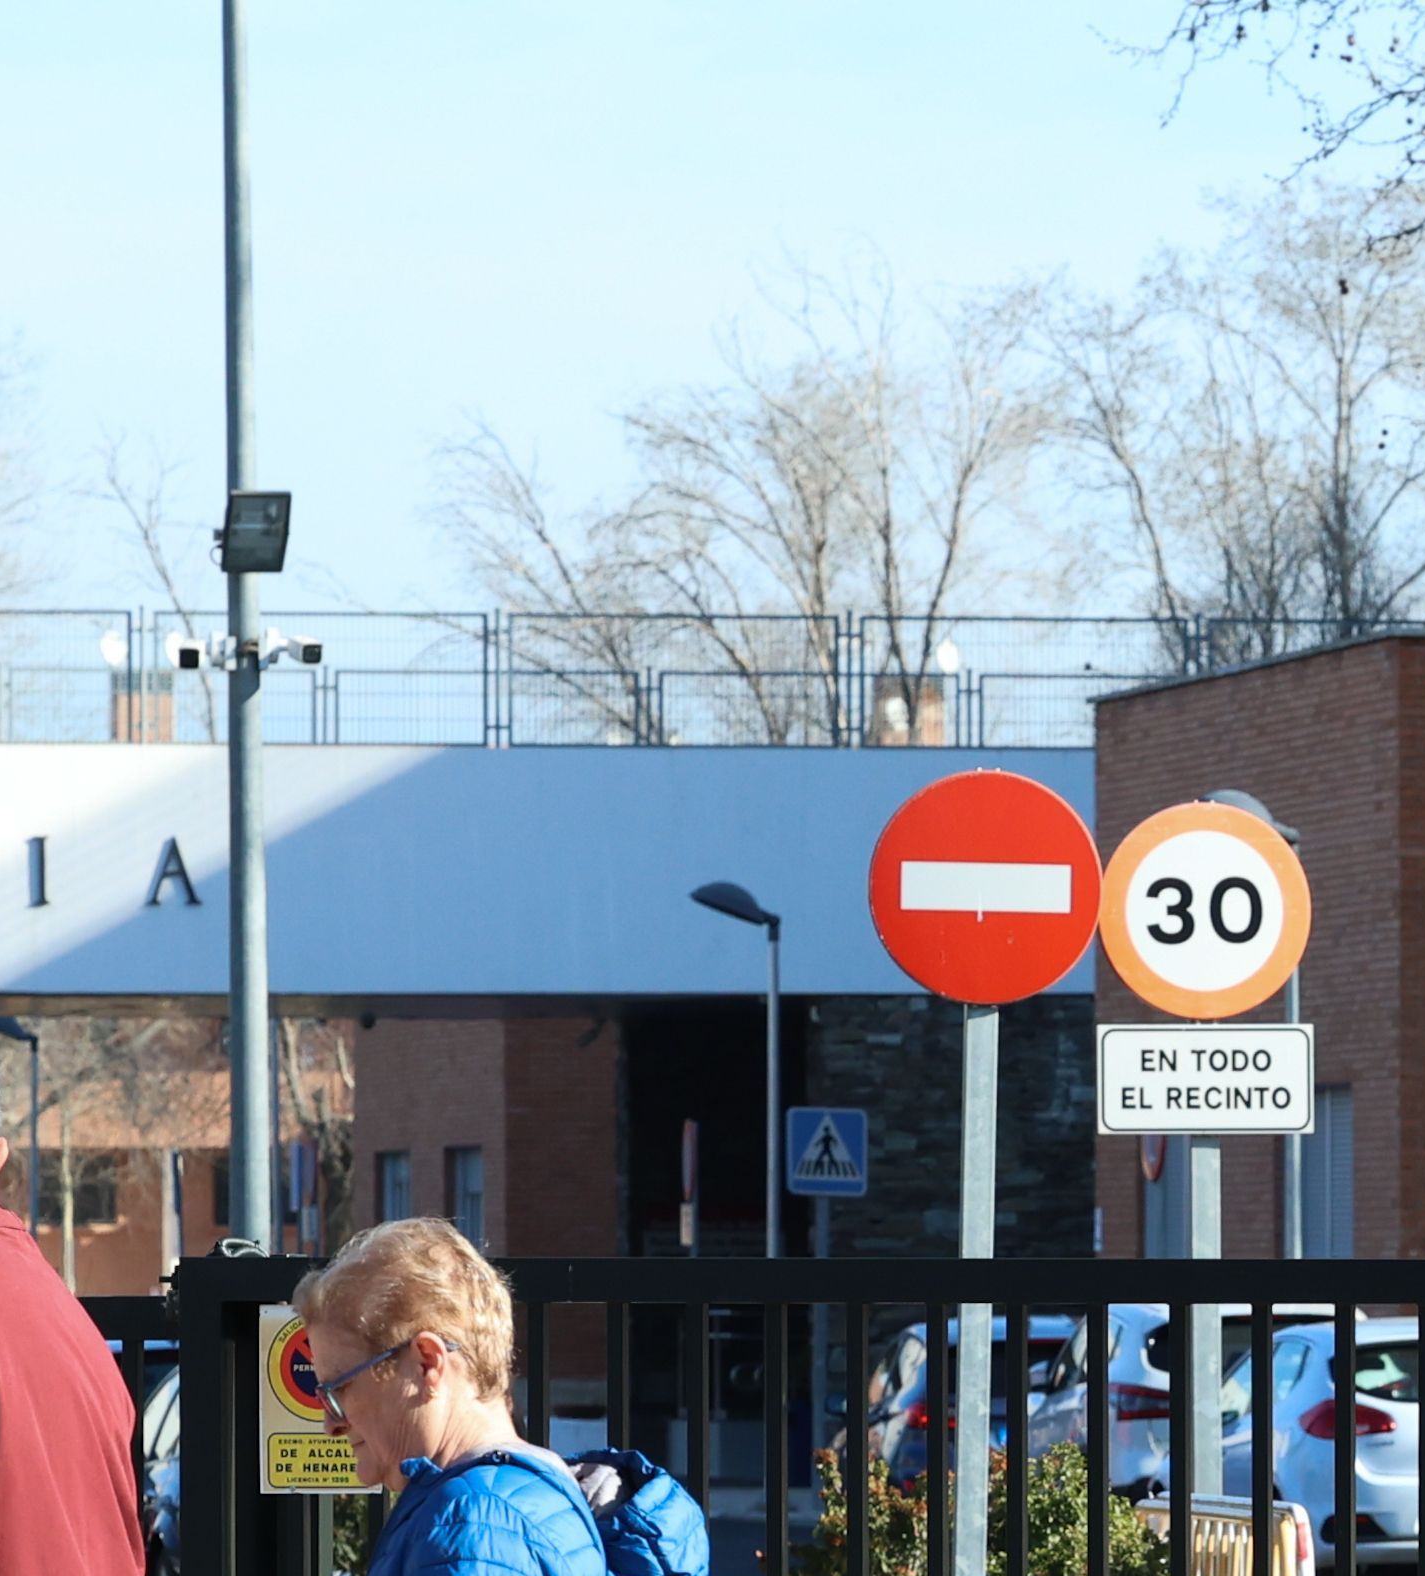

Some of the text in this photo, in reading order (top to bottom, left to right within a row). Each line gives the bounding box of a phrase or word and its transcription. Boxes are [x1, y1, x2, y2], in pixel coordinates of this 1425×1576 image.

[1146, 876, 1263, 945] 30
[1140, 1049, 1272, 1072] EN TODO
[1121, 1086, 1292, 1110] EL RECINTO
[280, 1448, 355, 1458] DE ALCAL
[275, 1463, 357, 1473] DE HENARE
